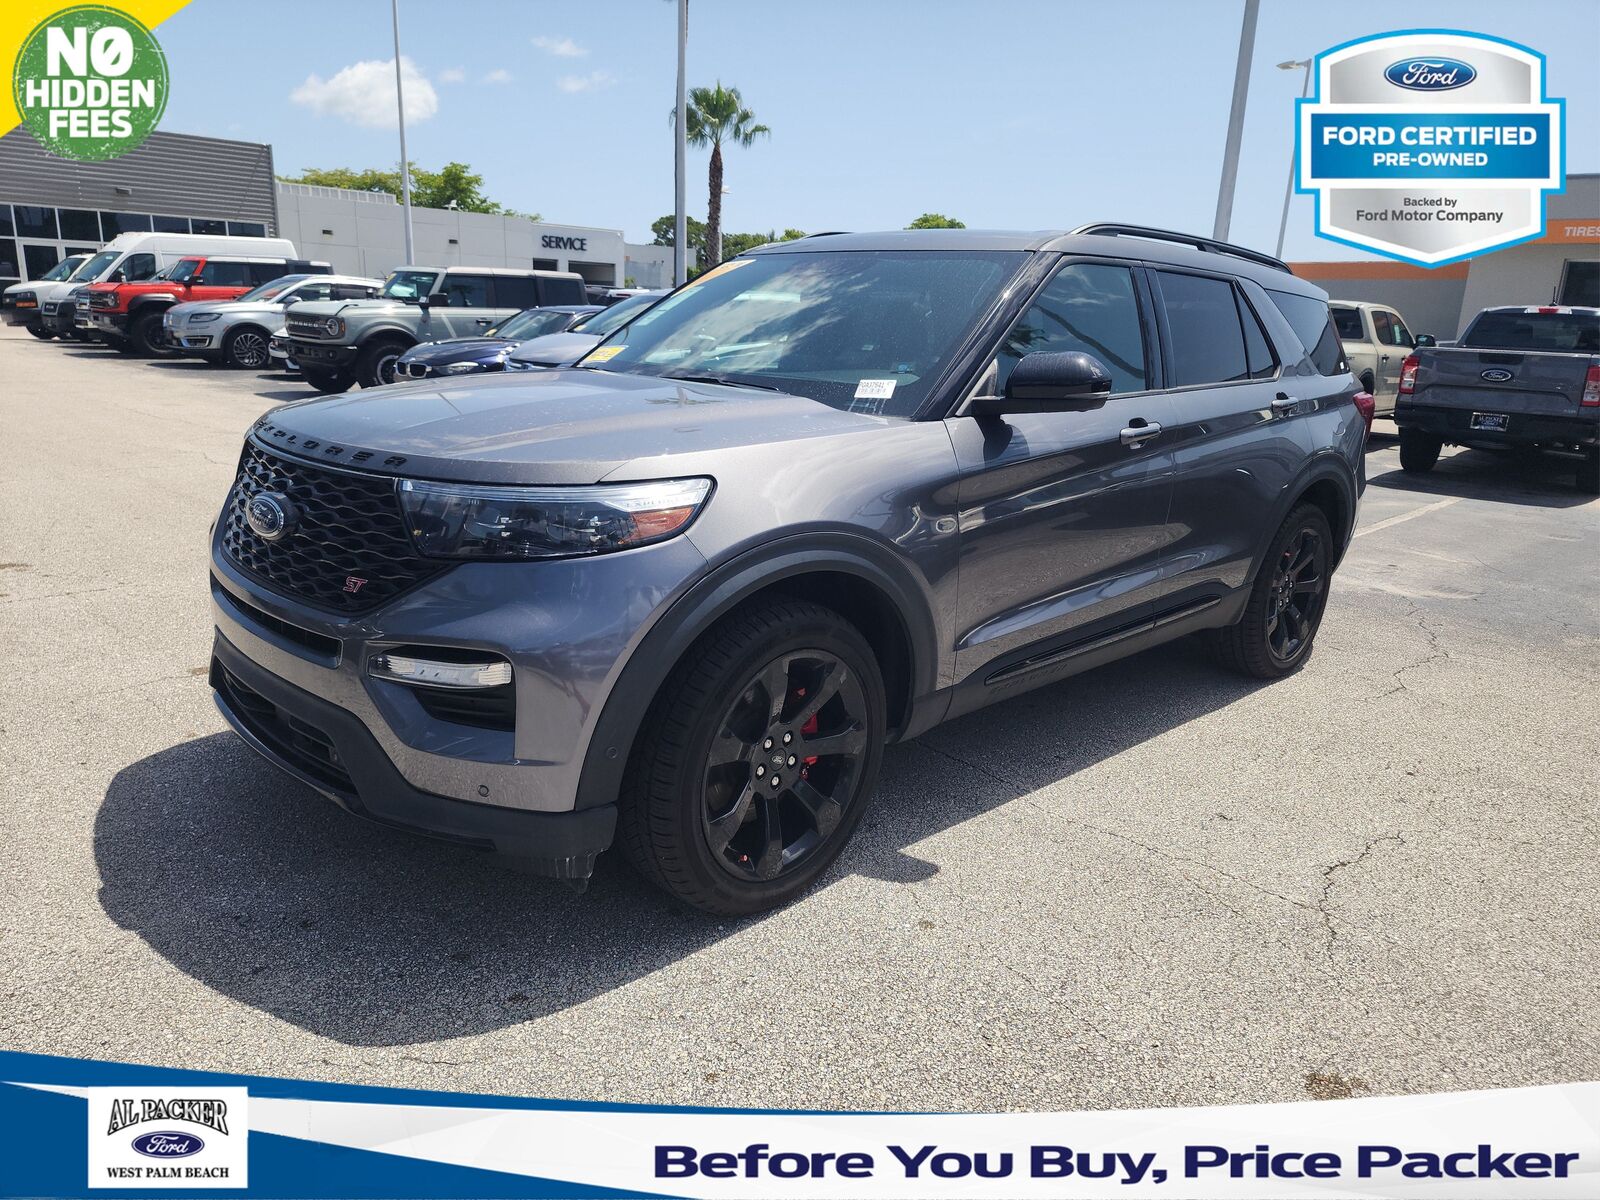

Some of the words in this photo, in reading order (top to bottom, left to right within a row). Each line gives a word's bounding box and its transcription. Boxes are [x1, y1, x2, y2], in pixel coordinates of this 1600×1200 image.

[1564, 226, 1600, 237] TIRES
[541, 235, 587, 251] SERVICE
[343, 576, 368, 593] ST
